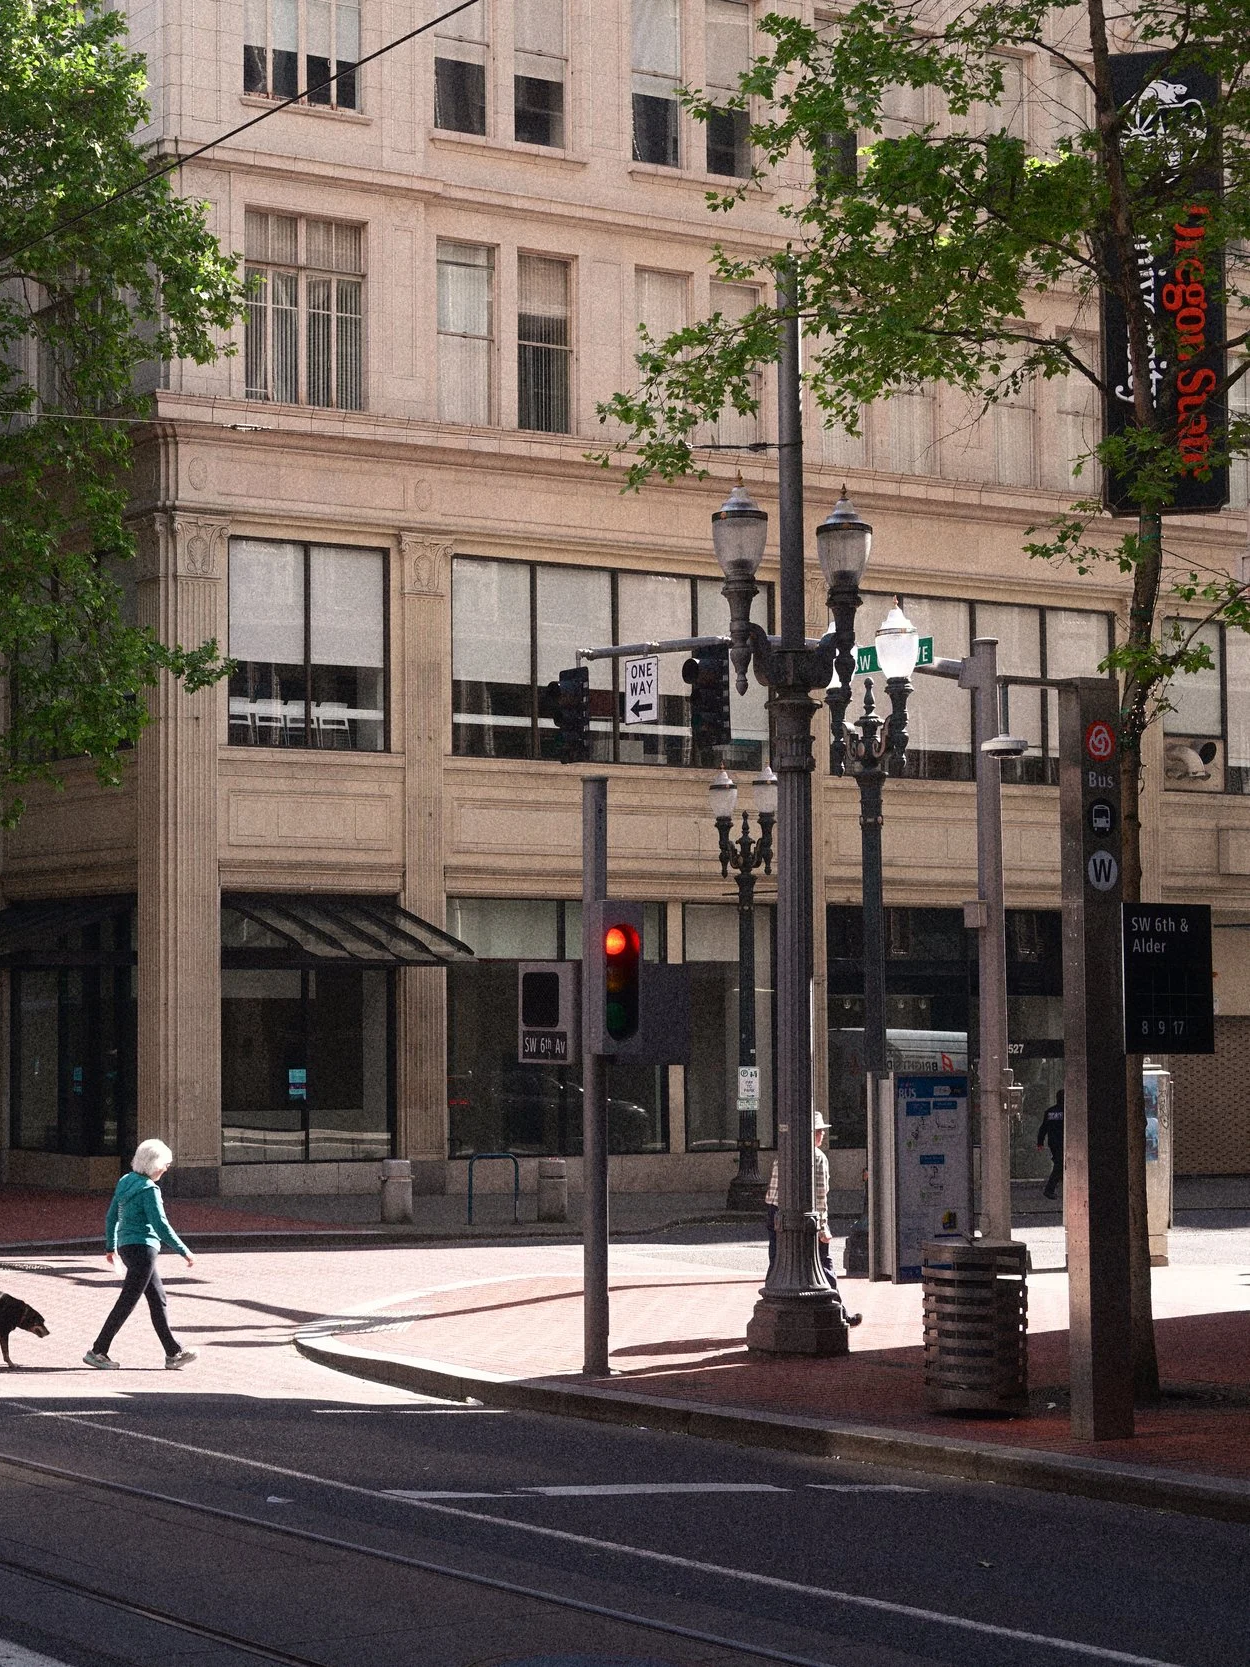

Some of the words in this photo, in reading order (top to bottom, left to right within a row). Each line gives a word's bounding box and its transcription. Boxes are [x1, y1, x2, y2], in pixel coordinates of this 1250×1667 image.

[631, 663, 653, 679] ONE
[630, 680, 654, 696] WAY
[1088, 771, 1114, 789] Bus
[1093, 859, 1112, 883] W
[1131, 916, 1150, 932] SW
[1154, 917, 1176, 932] 6th
[1180, 918, 1189, 932] &
[1132, 938, 1167, 953] Alder
[1141, 1020, 1149, 1035] 8
[1158, 1020, 1166, 1035] 9
[1172, 1020, 1185, 1035] 17
[524, 1037, 537, 1053] SW
[540, 1037, 552, 1053] 6th
[555, 1038, 566, 1054] Av
[1008, 1043, 1025, 1054] 527
[898, 1087, 917, 1099] BUS
